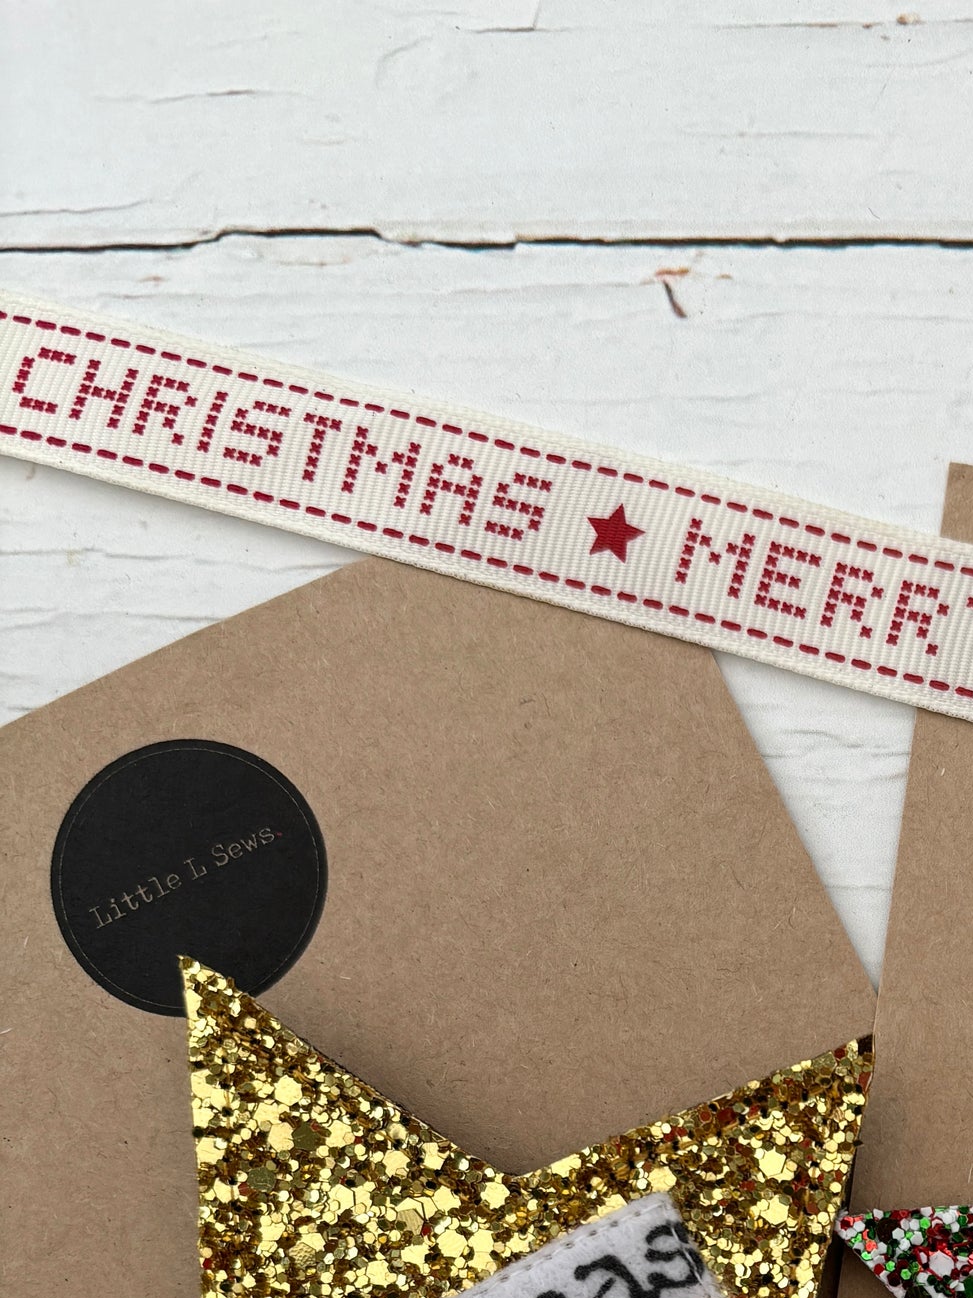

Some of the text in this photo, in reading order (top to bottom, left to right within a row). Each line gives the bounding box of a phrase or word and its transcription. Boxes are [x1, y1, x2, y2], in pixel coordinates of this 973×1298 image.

[13, 347, 552, 540] CHRISTMAS
[89, 827, 283, 929] Little L Sews.
